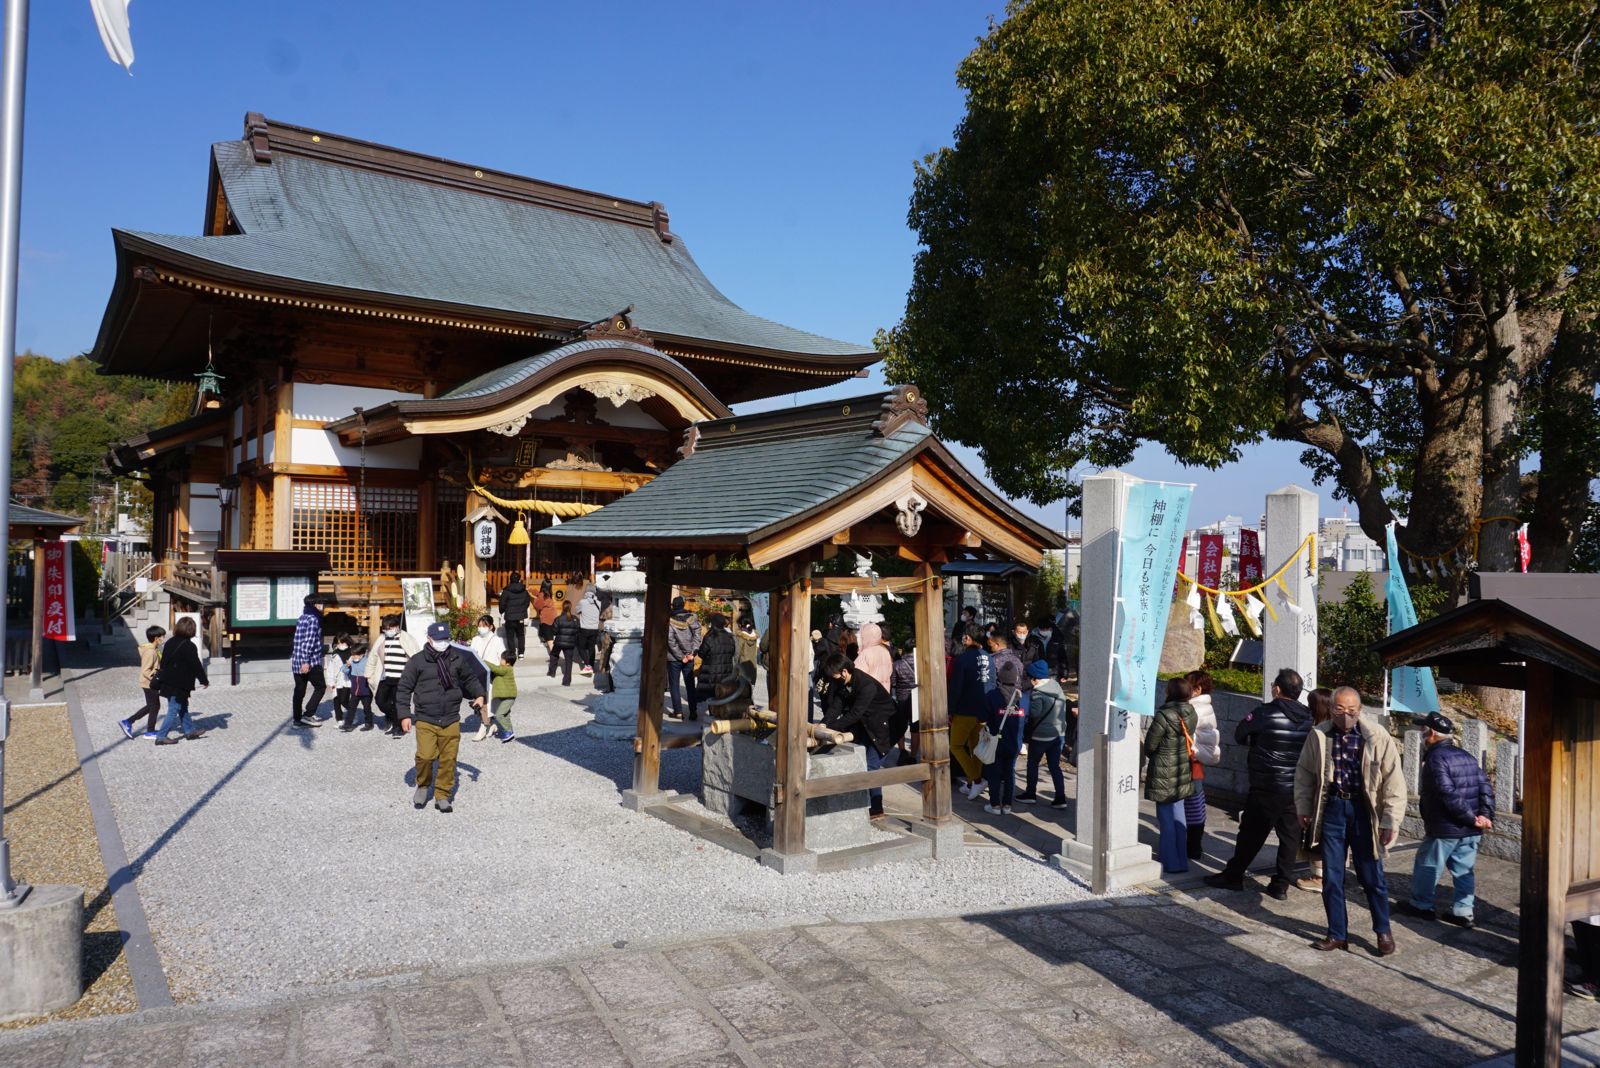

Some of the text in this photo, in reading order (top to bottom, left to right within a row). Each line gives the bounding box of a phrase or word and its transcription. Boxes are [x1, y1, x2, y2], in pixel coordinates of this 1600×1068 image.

[1148, 499, 1167, 538] 神棚に
[47, 547, 64, 634] 御朱印受付
[1138, 543, 1157, 624] 今日も家族の
